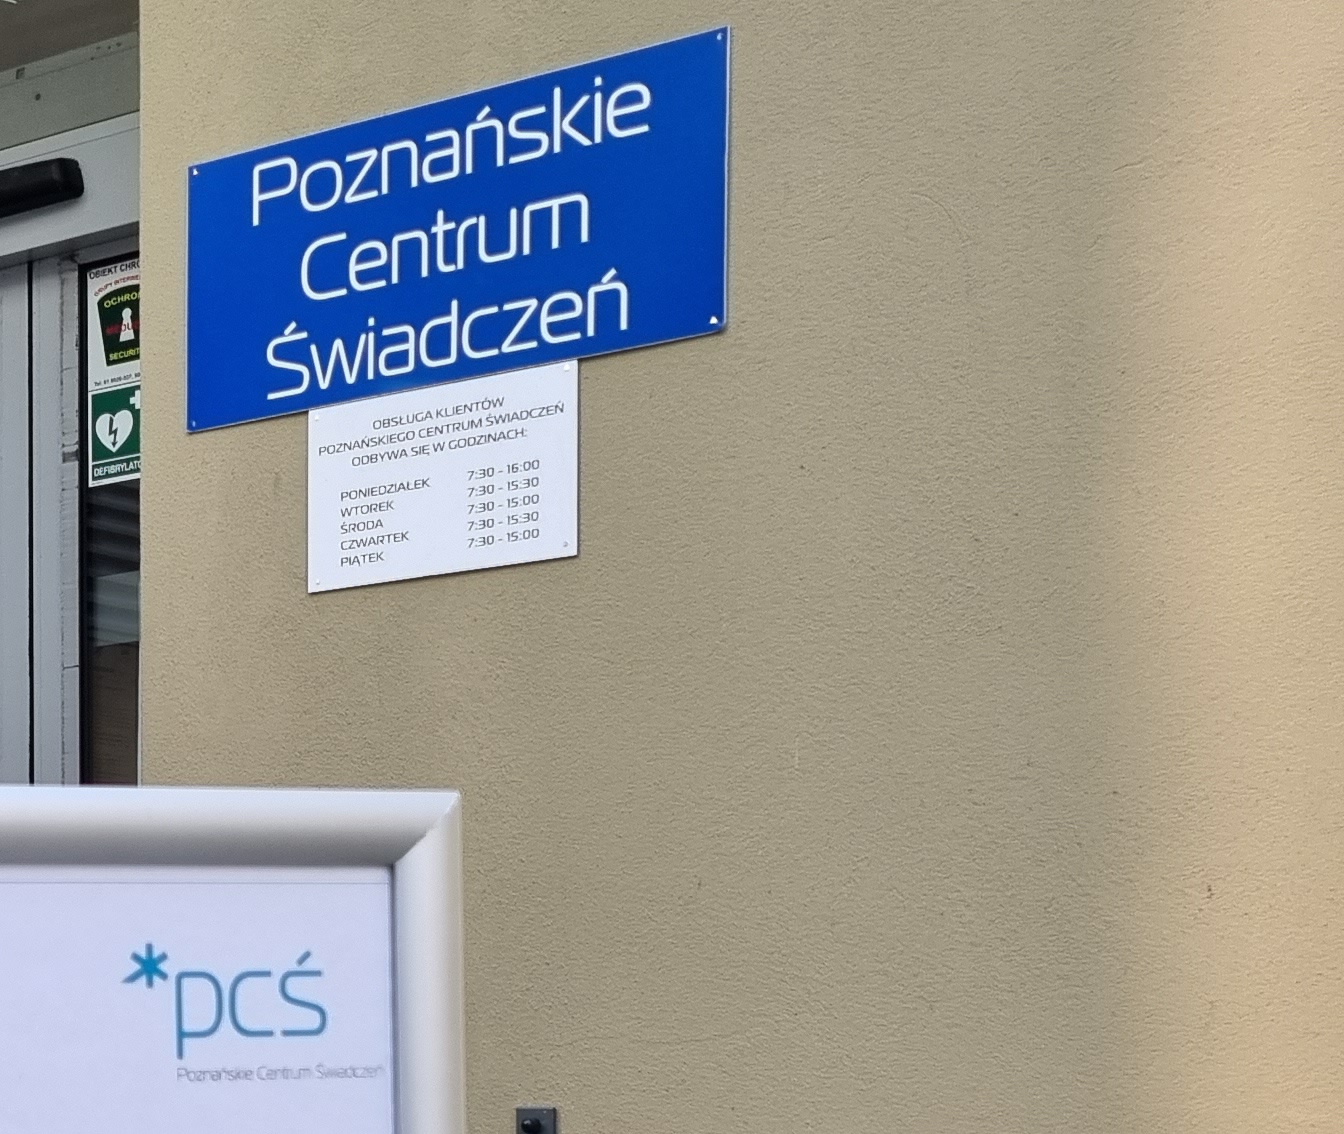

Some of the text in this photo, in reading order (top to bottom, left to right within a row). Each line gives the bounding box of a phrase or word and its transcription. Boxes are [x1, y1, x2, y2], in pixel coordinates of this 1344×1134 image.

[251, 76, 651, 226] Poznańskie
[301, 193, 589, 300] Centrum
[89, 266, 117, 280] OBIEKT
[104, 292, 140, 308] OCHRO
[266, 268, 628, 400] Świadczeń
[318, 402, 565, 456] POZNAŃSKIEGO CENTRUM ŚWIADCZEŃ
[373, 397, 505, 430] OBSŁUGA KLIENTÓW
[352, 427, 527, 467] ODBYWA SIĘ W GODZINACH:
[341, 478, 431, 501] PONIEDZIAŁEK
[467, 467, 494, 481] 7:30
[507, 460, 539, 474] 16:00
[341, 501, 394, 518] WTOREK
[467, 484, 494, 497] 7:30
[507, 477, 539, 491] 15:30
[341, 519, 383, 534] ŚRODA
[467, 501, 494, 515] 7:30
[507, 494, 539, 508] 15:00
[341, 531, 409, 550] CZWARTEK
[467, 518, 494, 531] 7:30
[507, 511, 539, 525] 15:30
[341, 552, 385, 567] PIĄTEK
[467, 535, 494, 548] 7:30
[507, 528, 539, 542] 15:00
[175, 950, 326, 1060] pcś
[256, 1066, 310, 1080] Centrum
